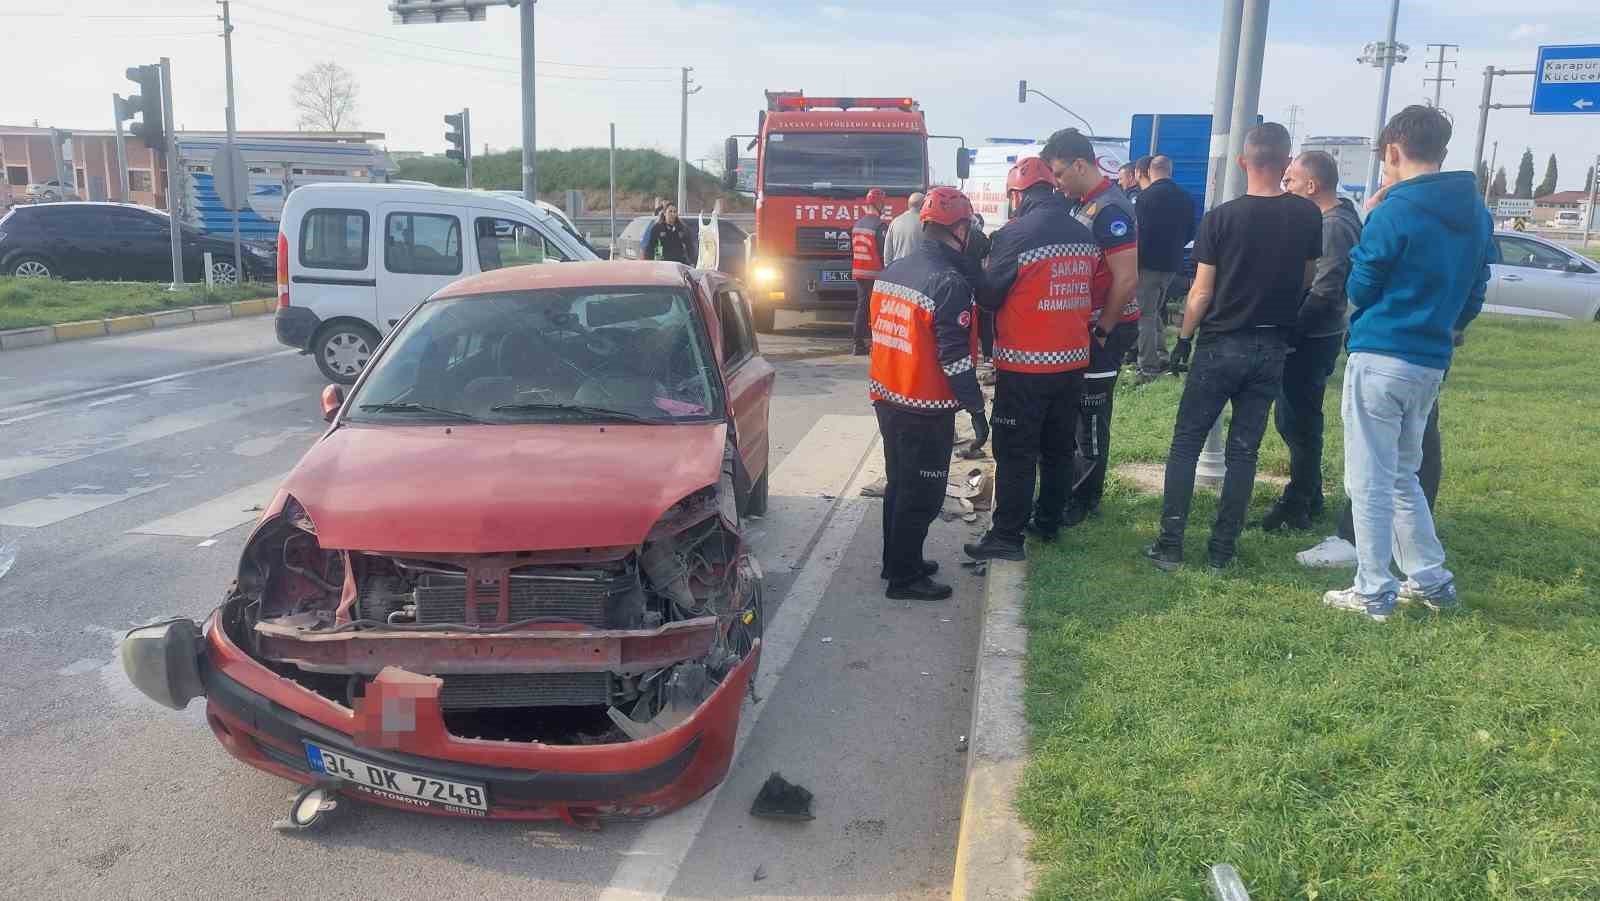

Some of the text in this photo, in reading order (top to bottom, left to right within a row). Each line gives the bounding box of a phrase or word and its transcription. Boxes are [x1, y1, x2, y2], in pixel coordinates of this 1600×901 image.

[824, 231, 851, 240] MA
[322, 753, 482, 806] 34 DK 7248
